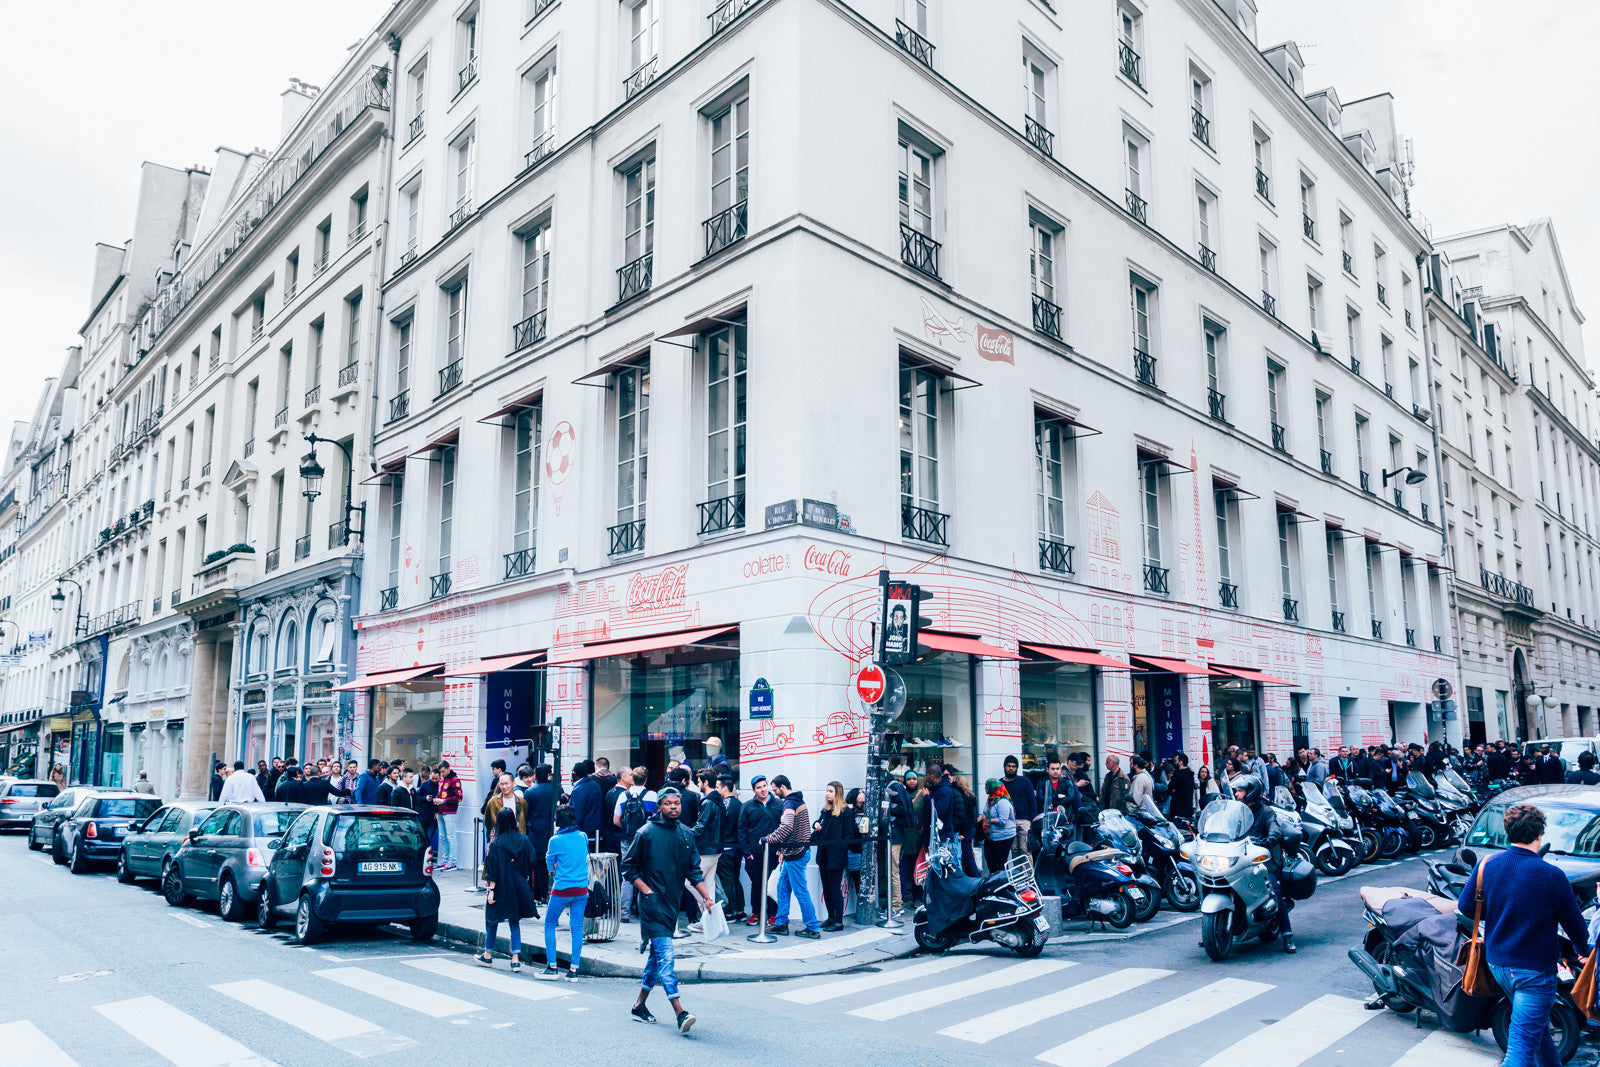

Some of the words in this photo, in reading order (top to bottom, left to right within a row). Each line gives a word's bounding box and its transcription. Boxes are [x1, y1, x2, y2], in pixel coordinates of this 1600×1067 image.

[774, 505, 786, 515] RUE
[743, 554, 784, 578] colette
[1163, 688, 1173, 740] MOINS
[374, 863, 387, 871] 915
